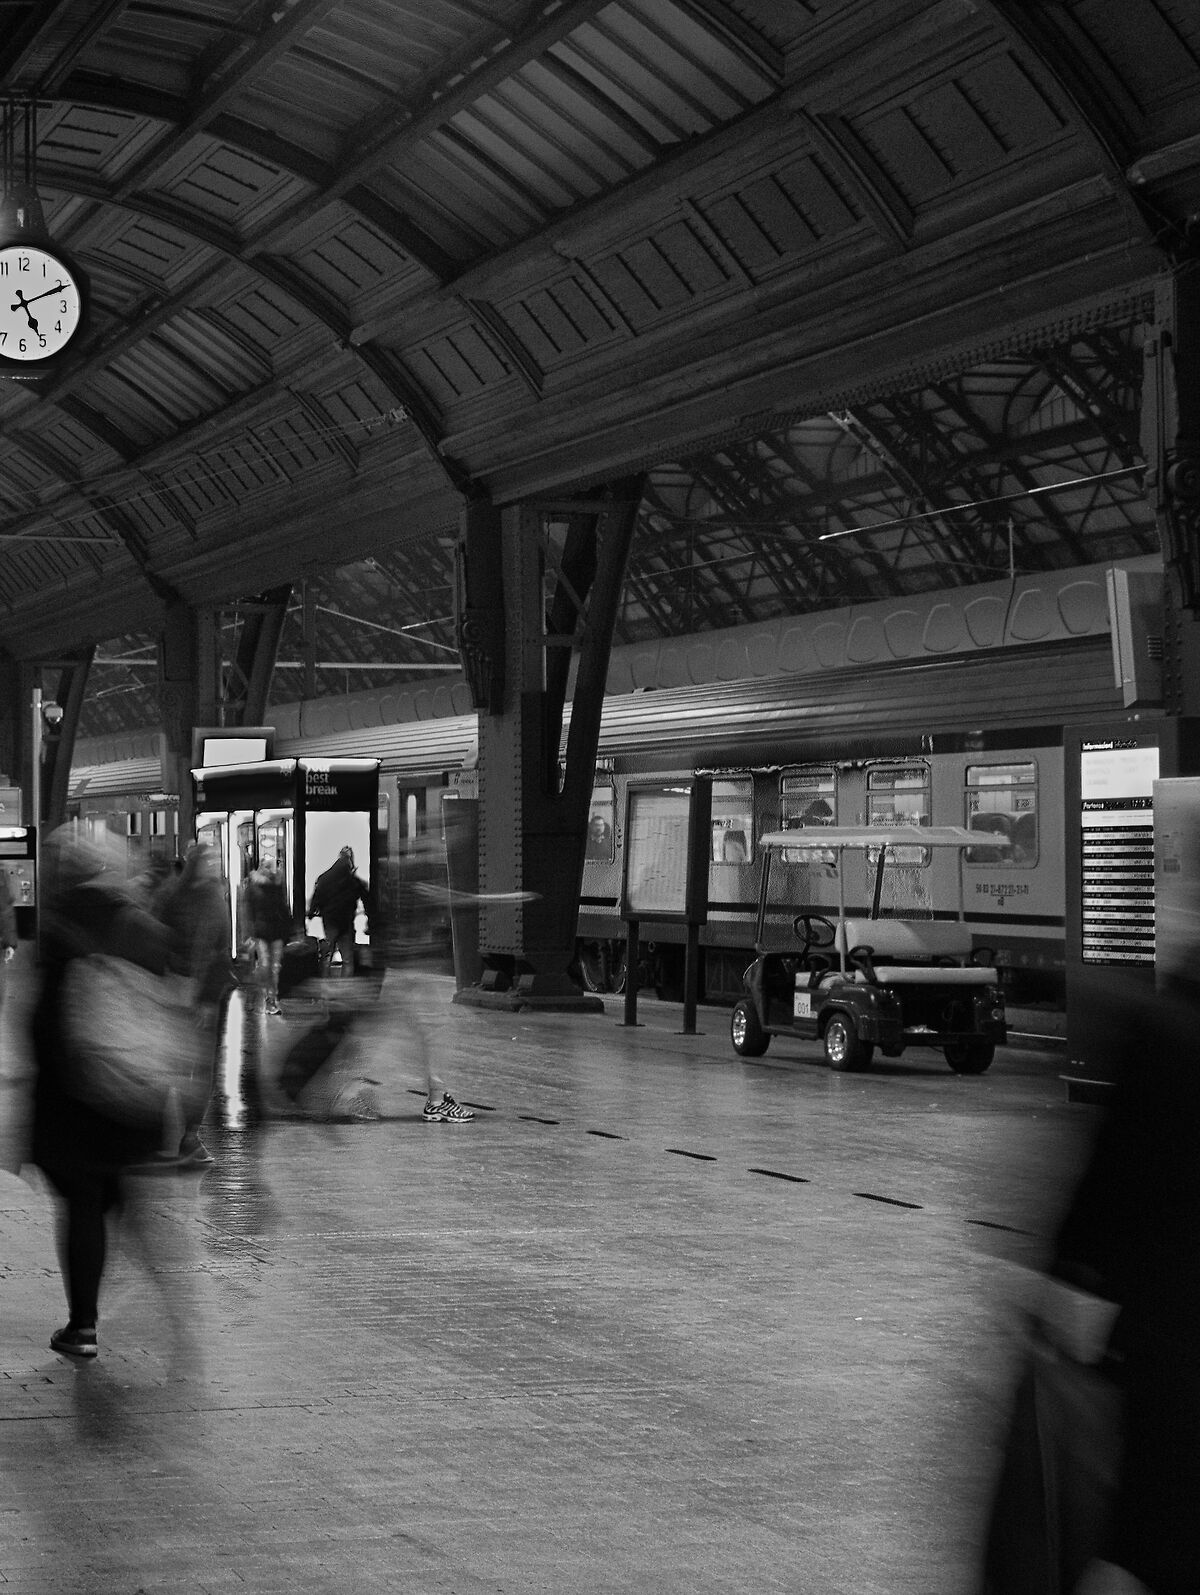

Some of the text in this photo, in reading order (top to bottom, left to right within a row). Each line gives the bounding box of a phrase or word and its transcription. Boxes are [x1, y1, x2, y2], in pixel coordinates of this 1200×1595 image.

[0, 262, 9, 276] 11
[18, 257, 30, 271] 12
[42, 263, 46, 278] 1
[60, 300, 67, 313] 3
[54, 320, 62, 333] 4
[0, 332, 7, 346] 7
[19, 338, 27, 352] 6
[39, 333, 47, 347] 5
[305, 770, 329, 783] best
[305, 784, 339, 795] break
[797, 1002, 809, 1015] 001
